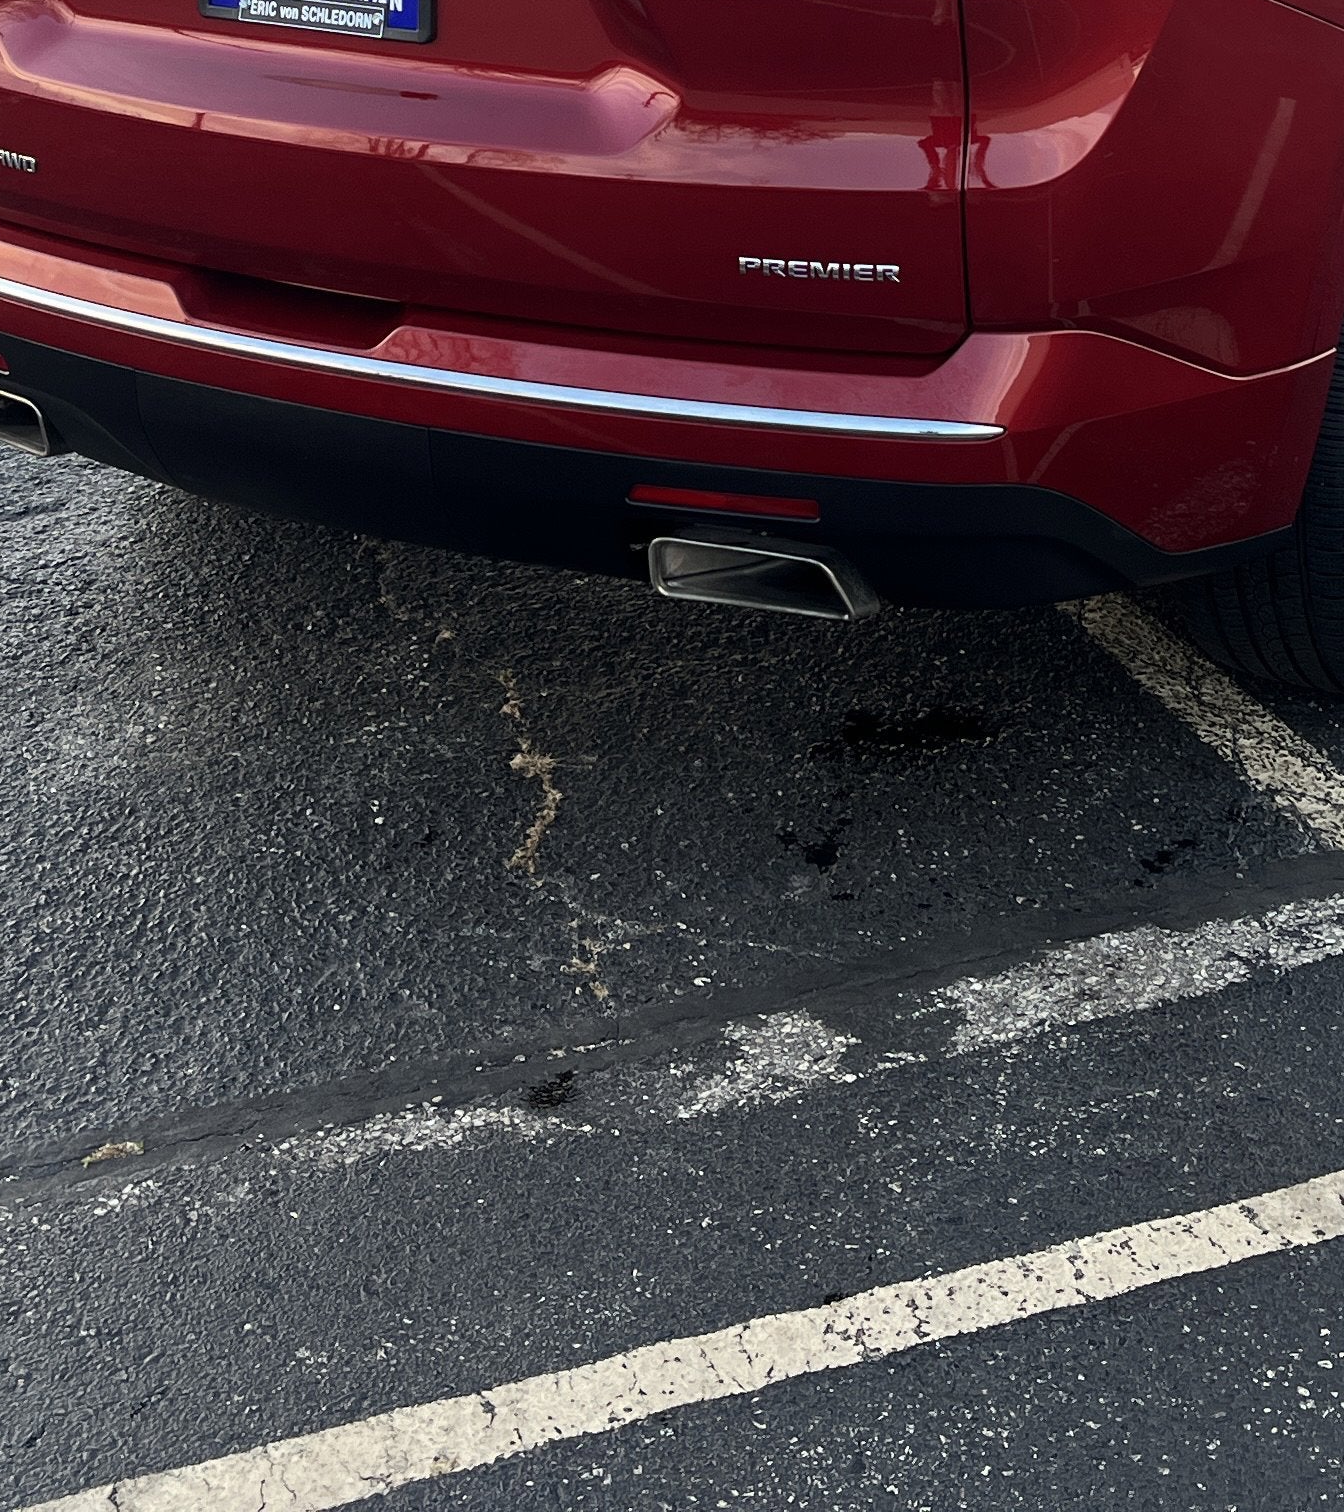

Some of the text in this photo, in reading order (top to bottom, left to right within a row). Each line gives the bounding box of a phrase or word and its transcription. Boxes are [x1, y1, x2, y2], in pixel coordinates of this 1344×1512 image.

[250, 0, 373, 29] ERIC von SCHLEDORN
[738, 256, 900, 283] PREMIER
